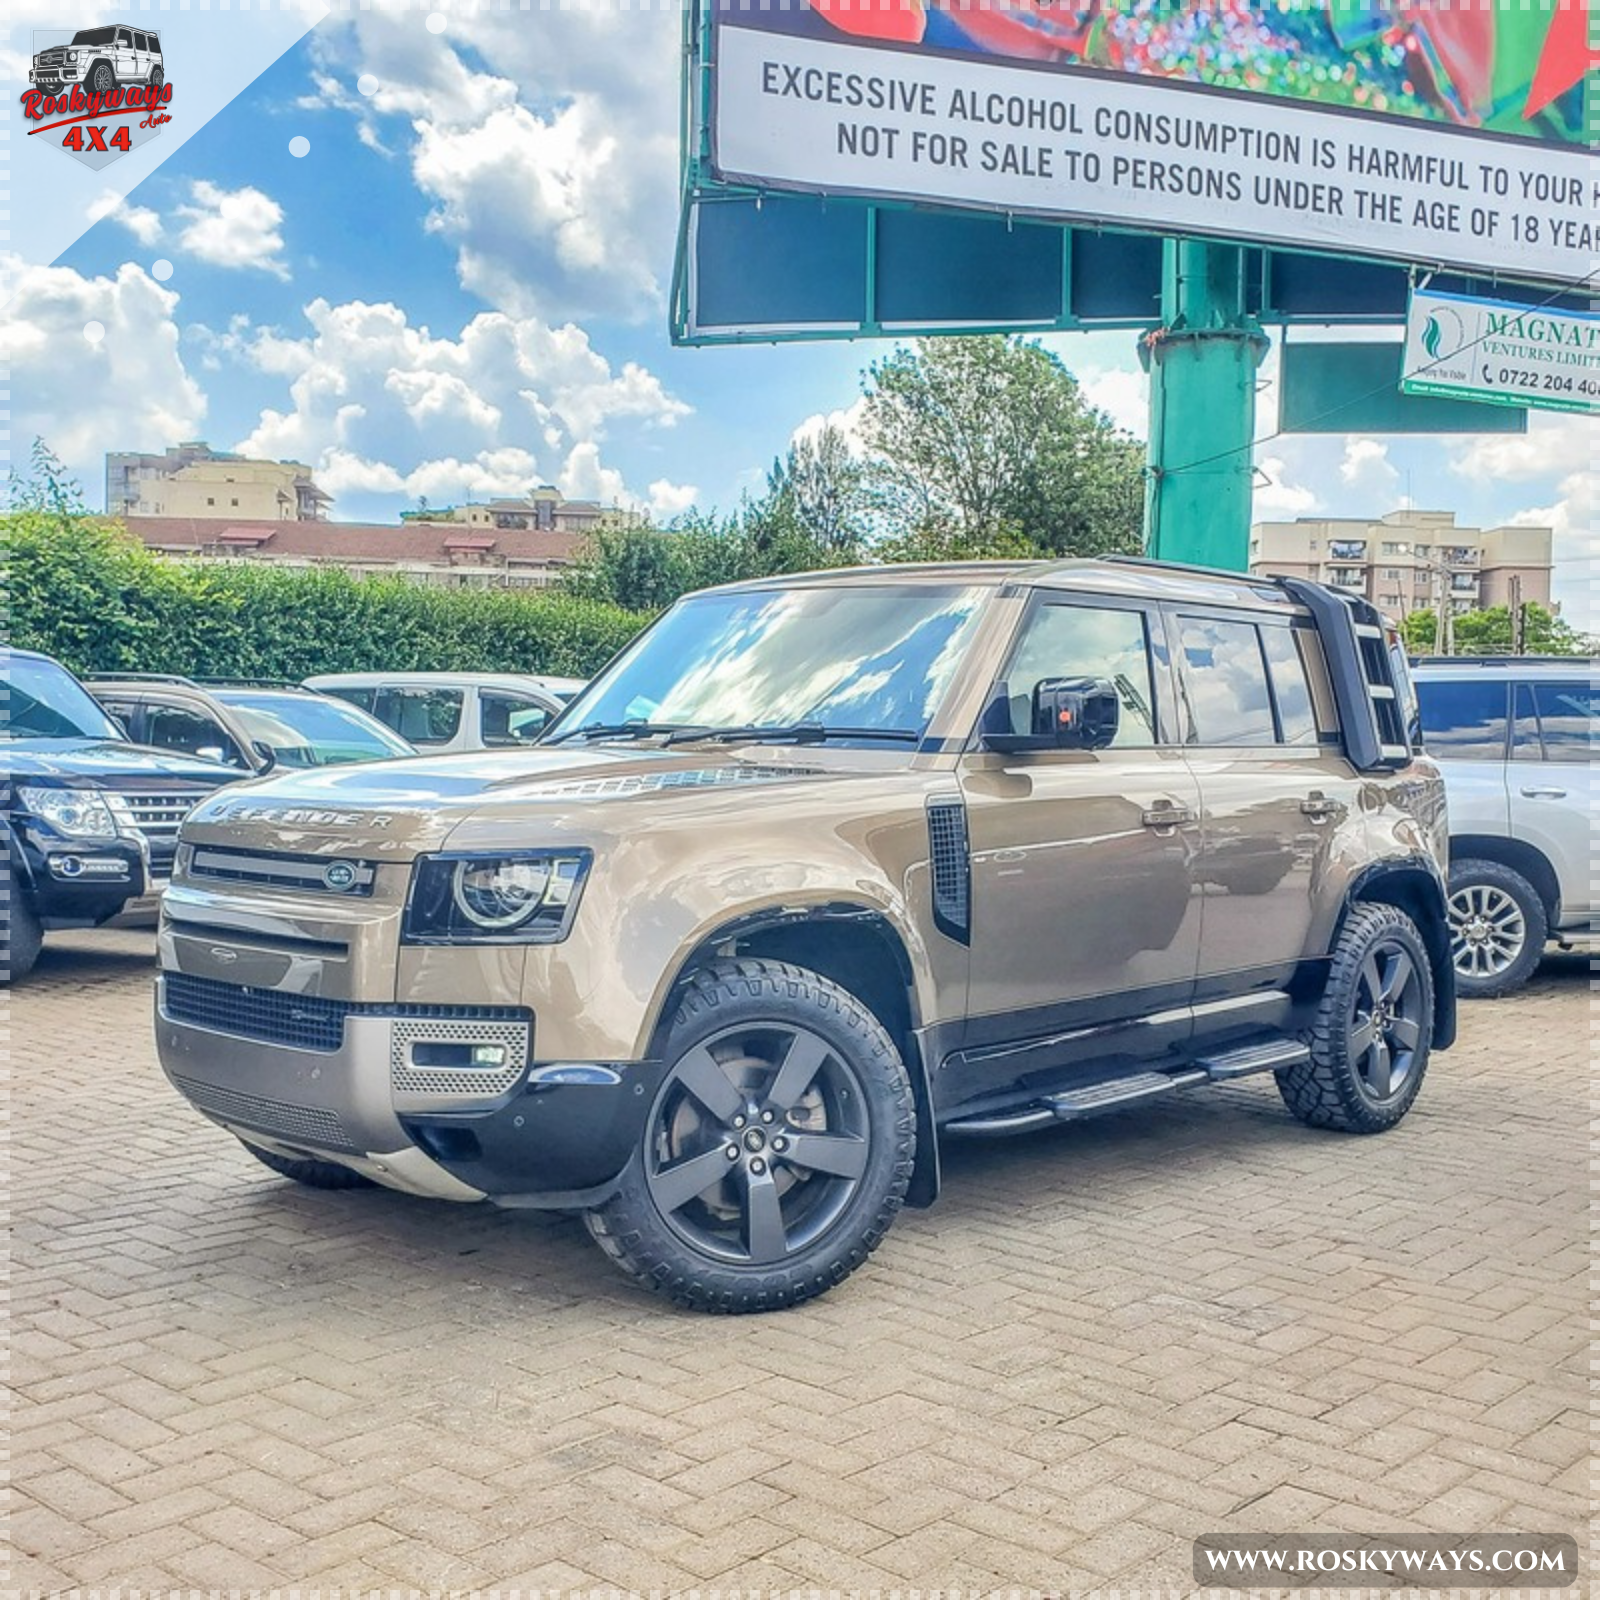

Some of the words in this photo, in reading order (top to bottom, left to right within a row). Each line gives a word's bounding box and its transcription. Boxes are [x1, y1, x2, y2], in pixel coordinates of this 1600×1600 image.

[762, 61, 936, 116] EXCESSIVE
[948, 89, 1083, 135] ALCOHOL
[1095, 107, 1300, 165] CONSUMPTION
[1311, 138, 1336, 169] IS
[1347, 144, 1469, 191] HARMFUL
[1479, 165, 1509, 197] TO
[1518, 171, 1583, 207] YOUR
[837, 123, 900, 159] NOT
[912, 131, 968, 169] FOR
[981, 141, 1053, 179] SALE
[1065, 150, 1101, 183] TO
[1113, 156, 1242, 202] PERSONS
[1253, 176, 1344, 216] UNDER
[1354, 190, 1402, 224] THE
[1412, 200, 1460, 234] AGE
[1471, 208, 1499, 239] OF
[1511, 215, 1540, 244] 18
[1483, 341, 1555, 362] VENTURES
[1499, 368, 1539, 388] 0722
[1544, 374, 1573, 392] 204
[1578, 379, 1600, 395] 40
